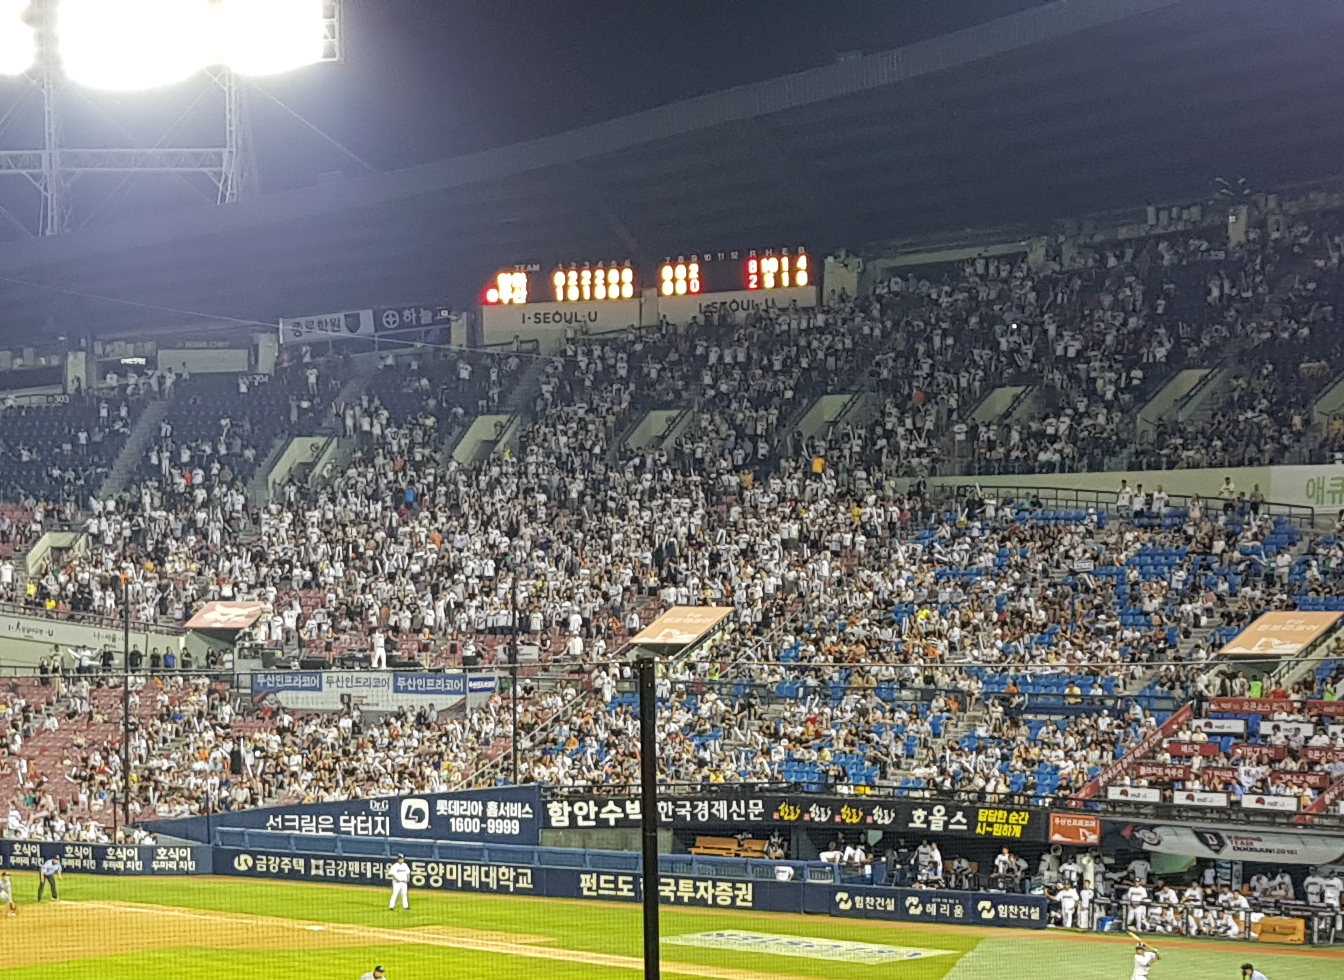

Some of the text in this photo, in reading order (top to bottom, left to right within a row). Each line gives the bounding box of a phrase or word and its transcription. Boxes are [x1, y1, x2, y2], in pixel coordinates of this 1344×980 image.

[256, 674, 320, 689] 두산인프라코어
[396, 676, 464, 692] 두산인프라코어
[436, 799, 533, 819] 롯데리아 홈서비스
[657, 799, 765, 823] 한국경제신문
[908, 805, 968, 831] 호올스
[1008, 811, 1030, 825] 순간
[265, 813, 391, 836] 선크림은 닥터지
[449, 817, 520, 835] 1600-9999
[13, 843, 41, 858] 호식이
[65, 845, 92, 860] 호식이
[107, 847, 138, 862] 호식이
[157, 847, 191, 862] 호식이
[82, 858, 96, 871] 치킨
[125, 859, 143, 872] 치킨
[178, 859, 196, 872] 치킨
[256, 856, 305, 875] 금강주택
[411, 862, 534, 891] 동양미래대학교
[579, 873, 754, 907] 펀드도 국투자증권
[854, 895, 895, 912] 힘찬건설
[998, 903, 1040, 921] 힘찬건설
